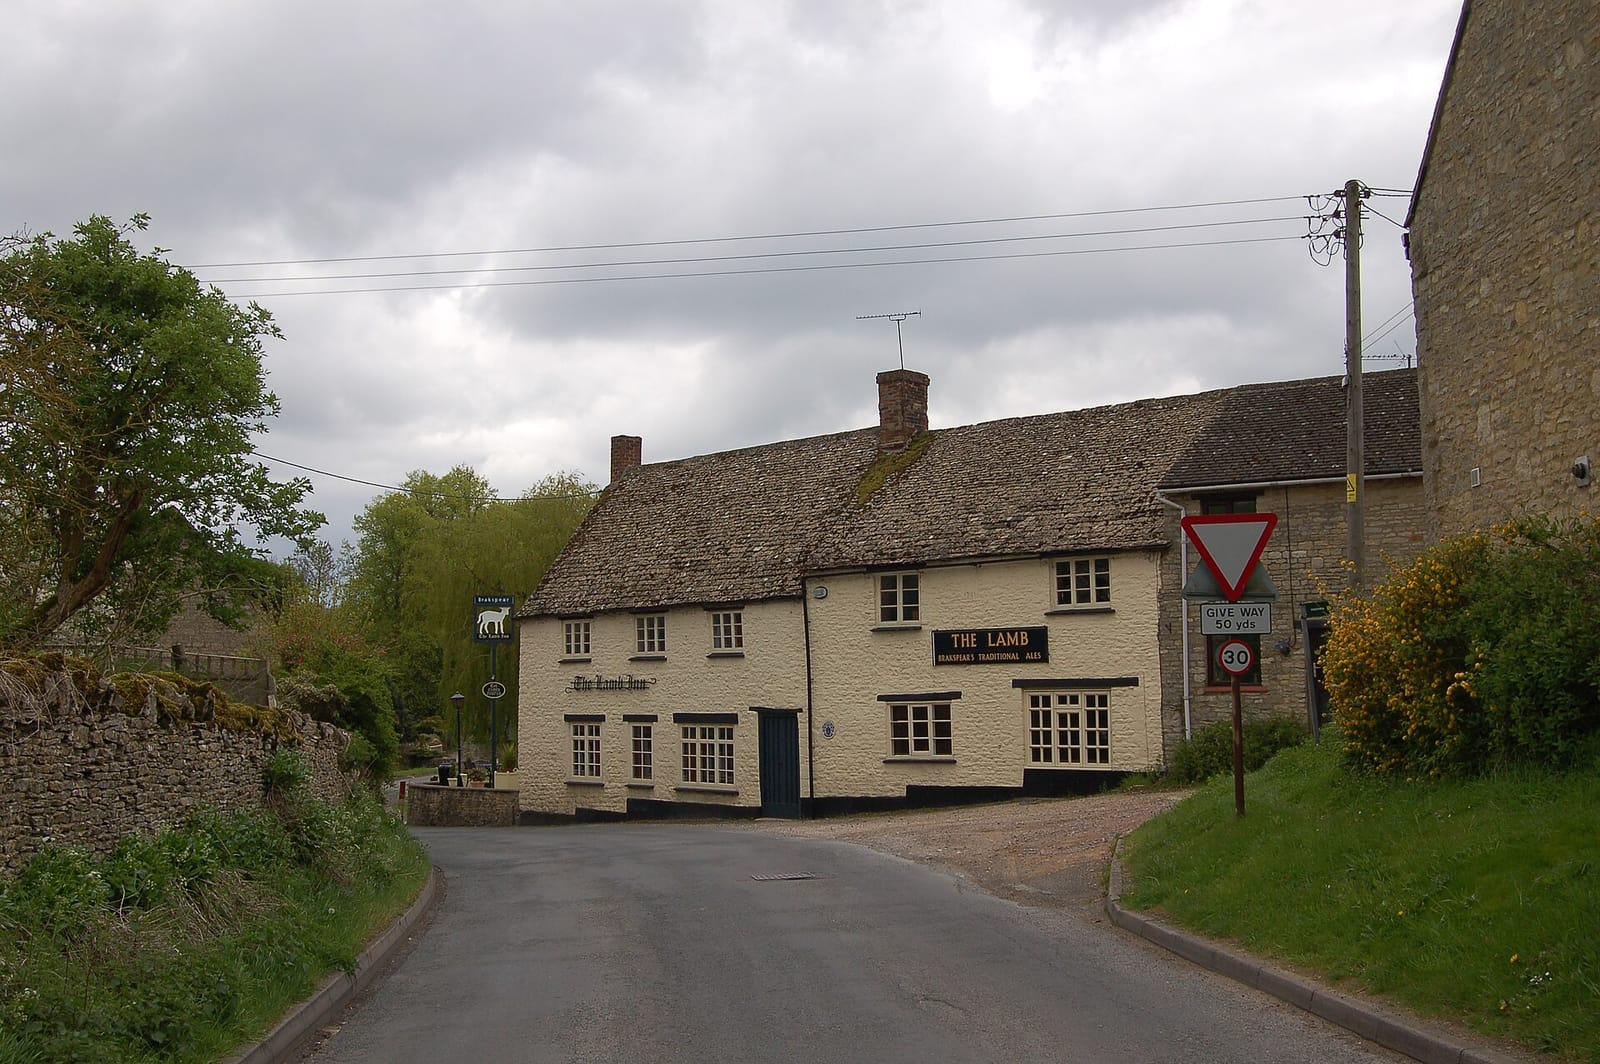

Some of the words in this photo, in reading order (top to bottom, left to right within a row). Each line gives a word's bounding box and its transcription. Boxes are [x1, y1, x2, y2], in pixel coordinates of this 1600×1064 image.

[1206, 608, 1235, 617] GIVE
[1240, 607, 1265, 617] WAY
[1215, 620, 1231, 629] 50
[1236, 620, 1256, 630] yds
[951, 633, 977, 648] THE
[987, 631, 1029, 647] LAMB
[978, 652, 1019, 661] TRADITIONAL
[1025, 651, 1042, 660] ALES
[1223, 650, 1249, 664] 30
[573, 675, 593, 691] The
[595, 674, 623, 690] Lamb
[625, 674, 646, 690] Inn
